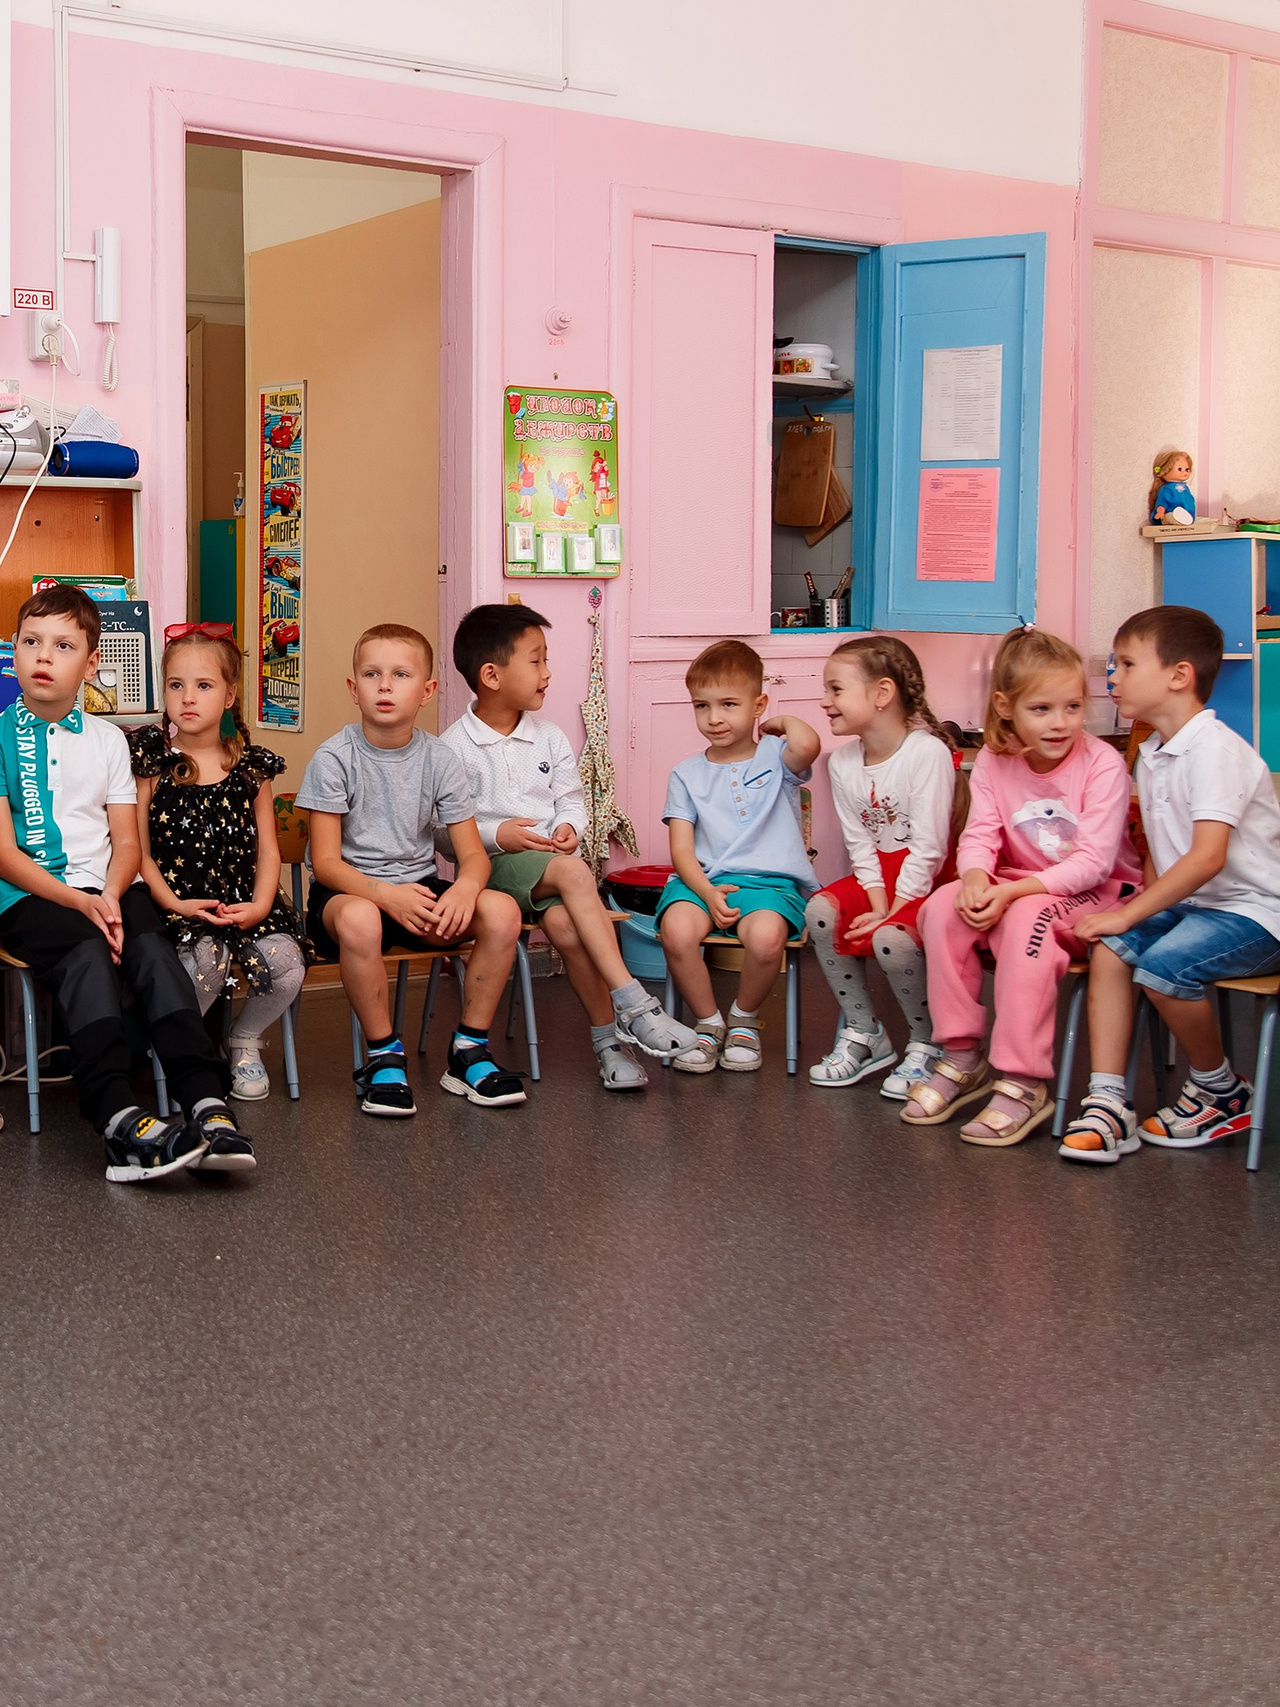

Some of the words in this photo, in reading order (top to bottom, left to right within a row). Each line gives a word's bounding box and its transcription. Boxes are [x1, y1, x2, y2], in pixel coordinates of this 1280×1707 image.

[17, 293, 38, 305] 220
[42, 295, 51, 306] В
[269, 394, 279, 408] ТАК
[270, 454, 300, 480] БЫСТРЕЕ!
[270, 591, 299, 620] ВЫШЕ!
[267, 678, 300, 698] ПОГНАЛИ
[15, 726, 37, 761] STAY
[19, 762, 46, 826] PLUGGED
[26, 827, 46, 846] IN
[1059, 889, 1101, 915] Almost
